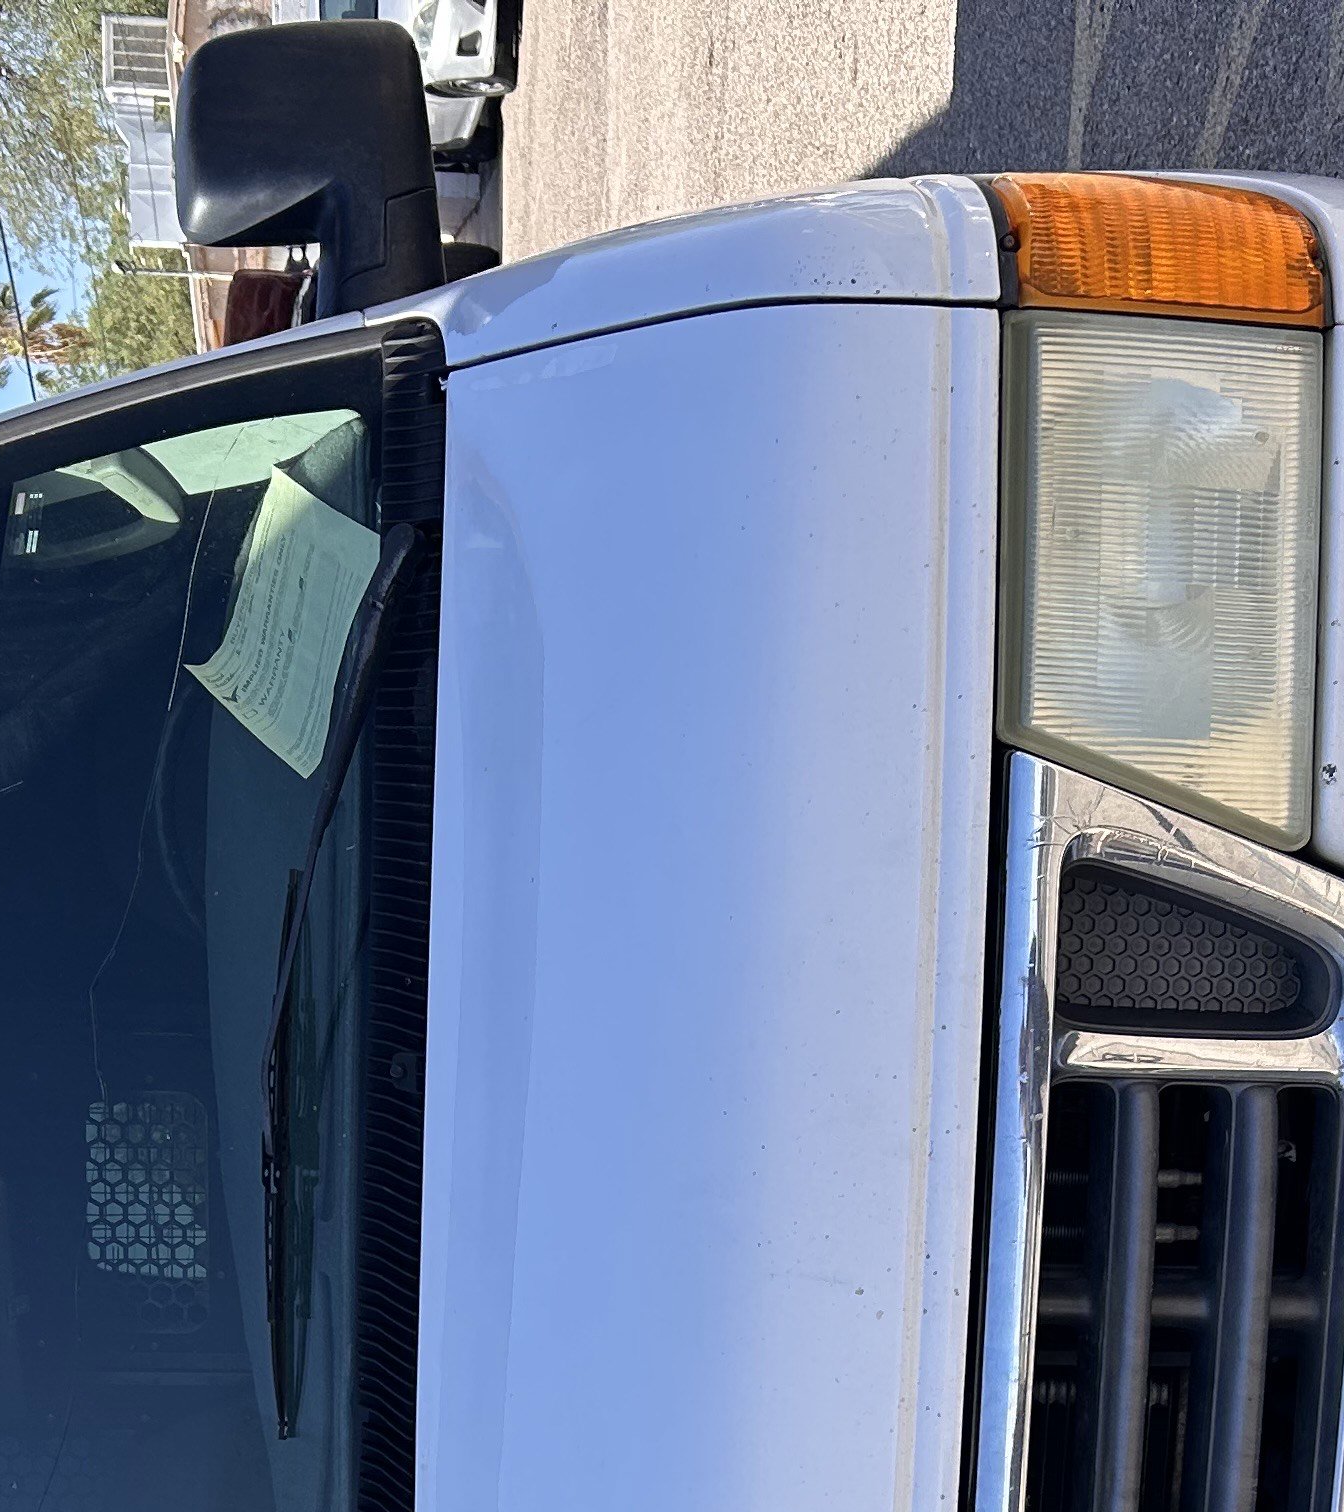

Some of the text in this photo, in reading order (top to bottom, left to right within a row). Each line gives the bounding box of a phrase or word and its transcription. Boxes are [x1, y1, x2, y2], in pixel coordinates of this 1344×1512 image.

[240, 648, 265, 693] IMPLIED
[260, 567, 280, 645] WARRANTIES
[275, 533, 288, 566] ONLY
[258, 627, 285, 706] WARRANTY
